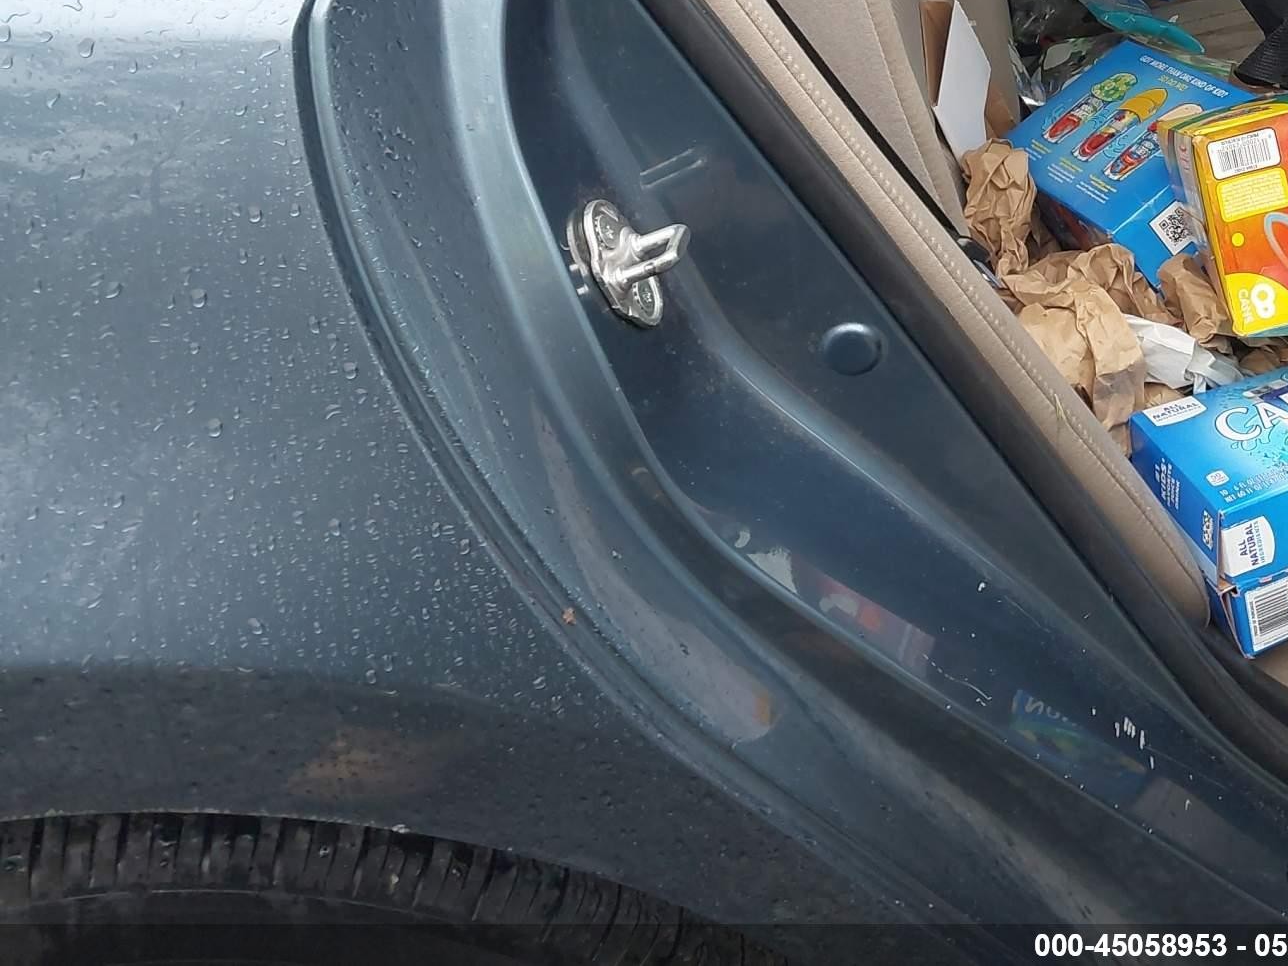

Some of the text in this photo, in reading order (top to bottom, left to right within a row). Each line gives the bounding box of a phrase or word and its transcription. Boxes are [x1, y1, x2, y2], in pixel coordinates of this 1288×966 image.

[1251, 281, 1275, 320] 8
[1152, 402, 1199, 420] NATURAL
[1163, 404, 1178, 412] ALL
[1239, 539, 1249, 557] ALL
[1245, 523, 1259, 567] NATURAL
